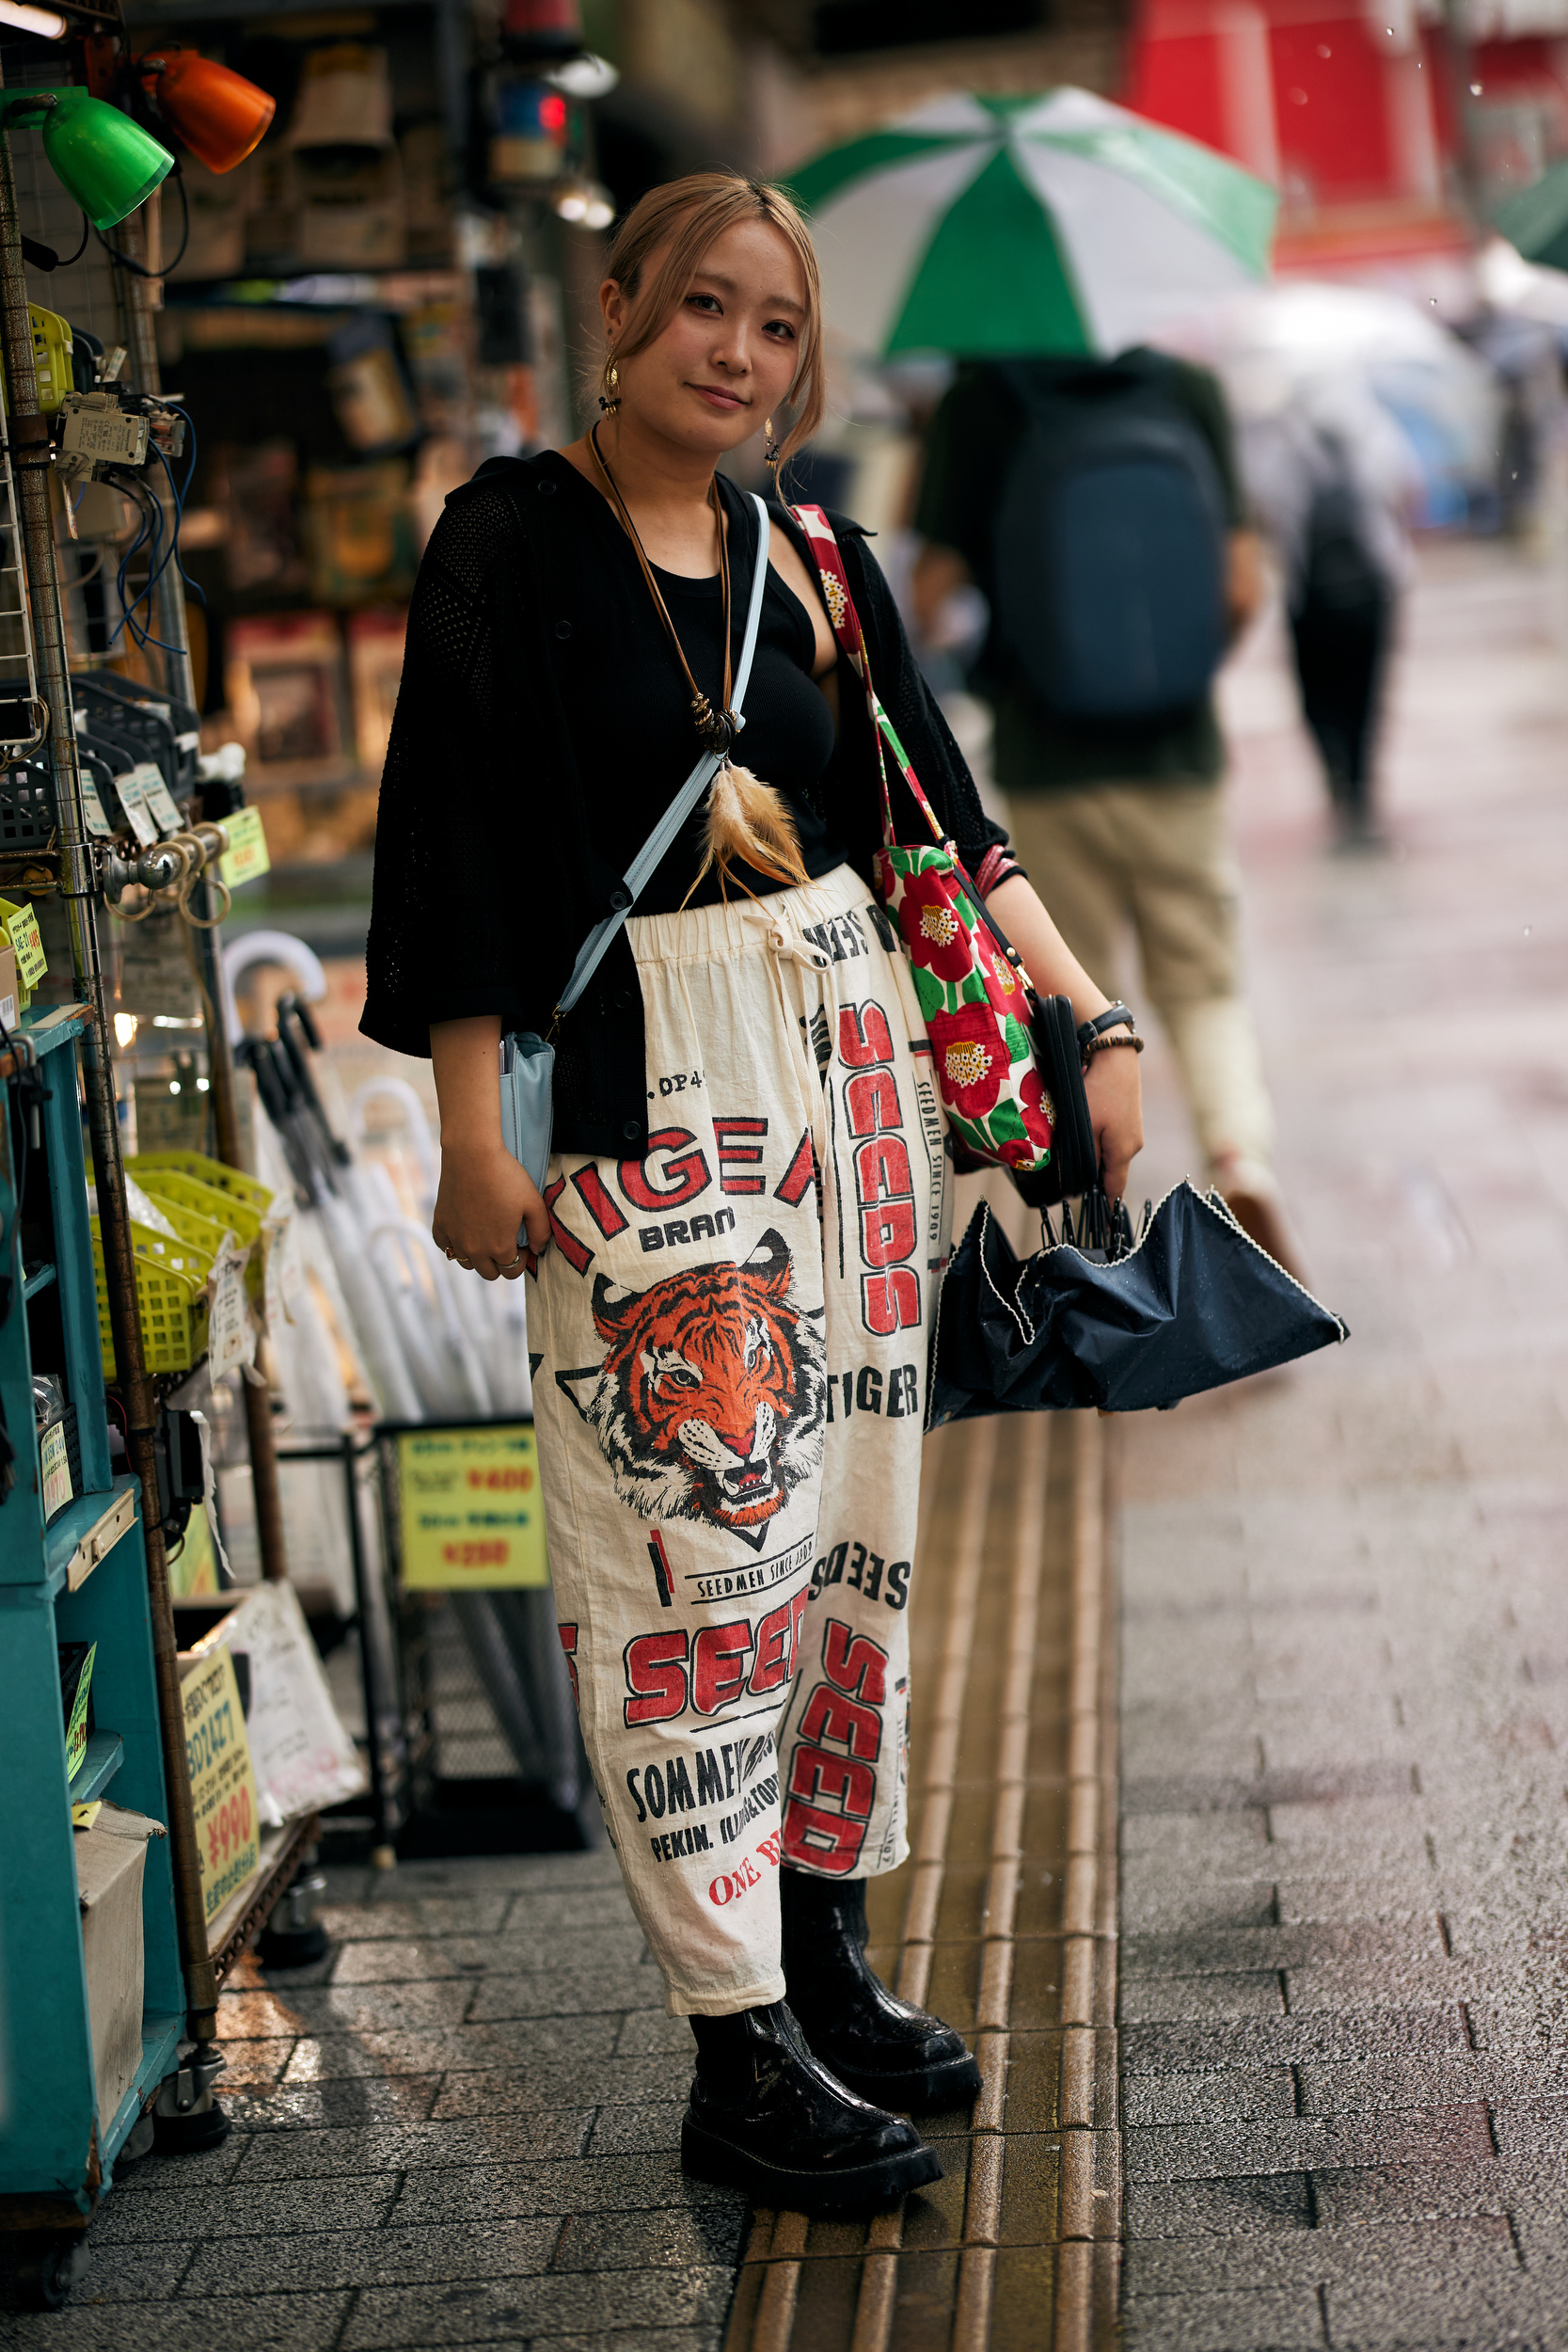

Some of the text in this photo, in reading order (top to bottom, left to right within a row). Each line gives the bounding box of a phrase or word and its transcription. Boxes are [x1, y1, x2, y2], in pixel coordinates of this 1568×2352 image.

[917, 1081, 942, 1241] SEEDMEN SINCE 1909
[826, 1364, 918, 1423] TIGER
[697, 1574, 765, 1597] SEEDMEN
[770, 1554, 793, 1581] SINCE
[807, 1540, 911, 1611] SEEDS
[206, 1785, 252, 1871] ¥990
[650, 1824, 714, 1863] PEKIN.
[708, 1857, 762, 1906] ONE
